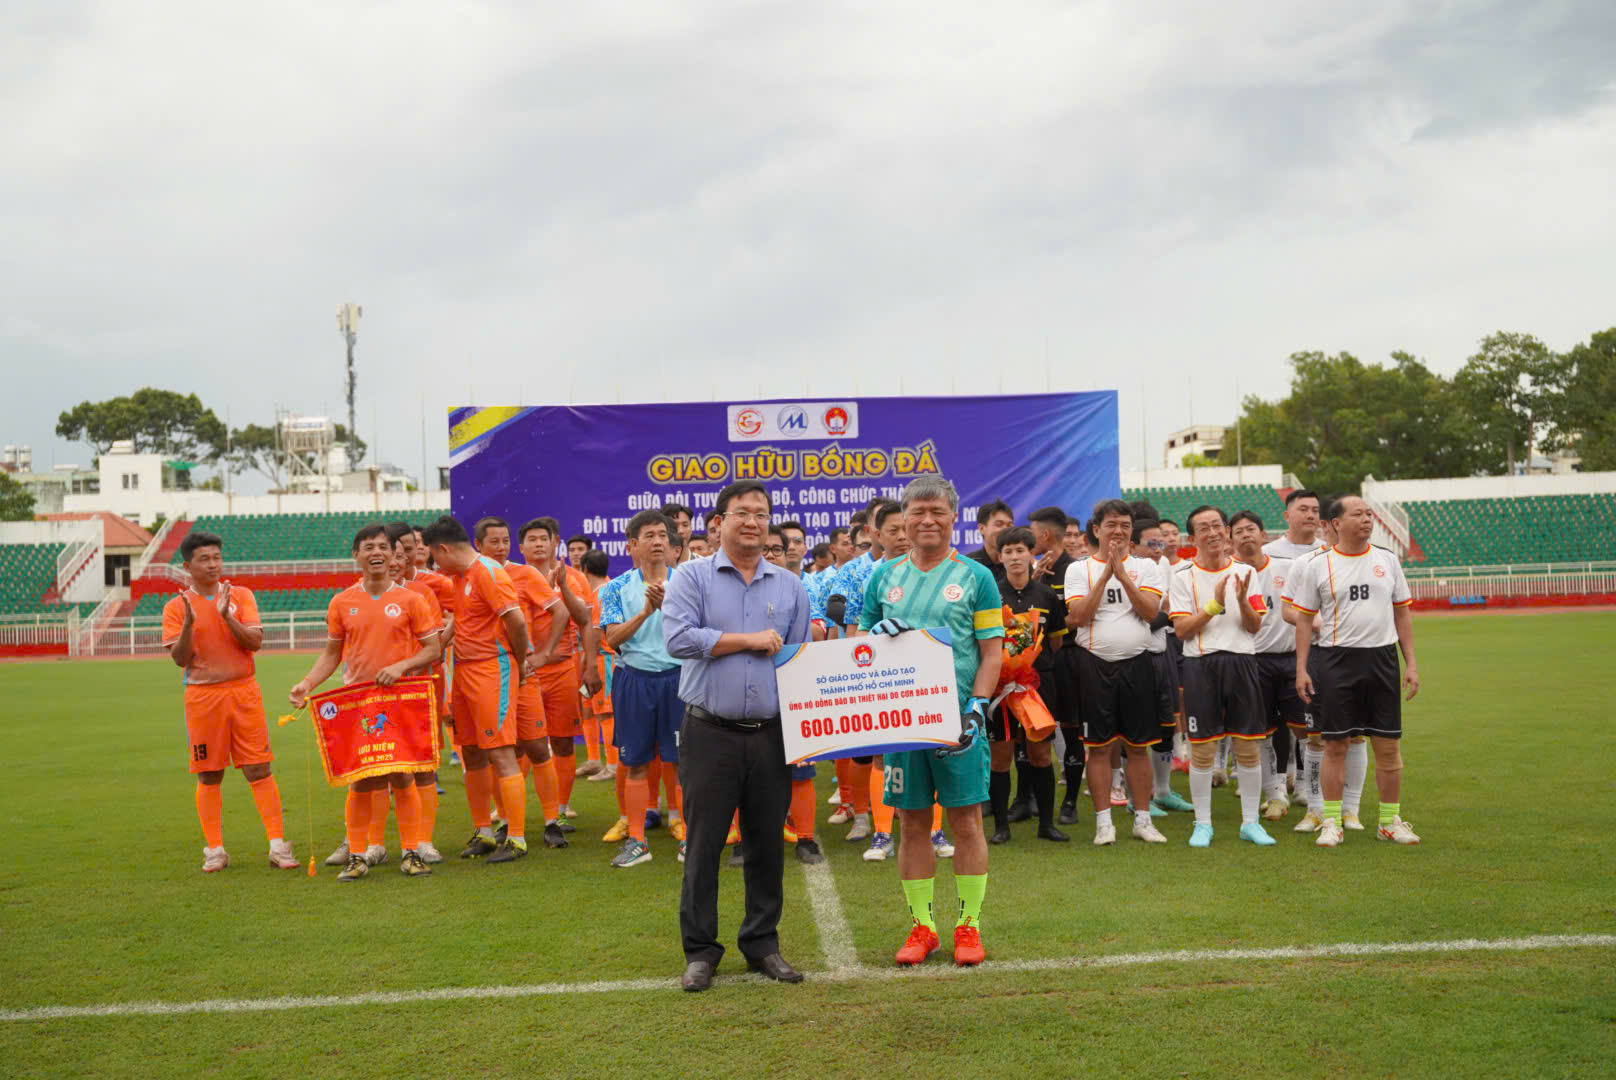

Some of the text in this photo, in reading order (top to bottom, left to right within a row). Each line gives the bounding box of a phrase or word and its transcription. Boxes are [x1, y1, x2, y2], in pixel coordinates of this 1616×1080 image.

[650, 444, 939, 482] GIAO HỮU BÓNG ĐÁ
[628, 491, 661, 510] GIỮA
[771, 487, 795, 508] BỘ,
[799, 486, 836, 505] CÔNG
[840, 485, 877, 504] CHỨC
[583, 515, 607, 537] ĐỘI
[804, 512, 830, 531] TẠO
[1107, 588, 1122, 604] 91
[1349, 584, 1370, 601] 88
[829, 673, 849, 683] GIÁO
[850, 672, 867, 682] DỤC
[868, 669, 880, 678] VÀ
[881, 667, 899, 677] ĐÀO
[900, 666, 916, 676] TẠO
[820, 678, 915, 695] THÀNH PHỐ HỒ CHÍ MINH
[800, 708, 943, 738] 600.000.000 ĐỒNG
[1188, 716, 1198, 732] 8
[193, 744, 208, 762] 19
